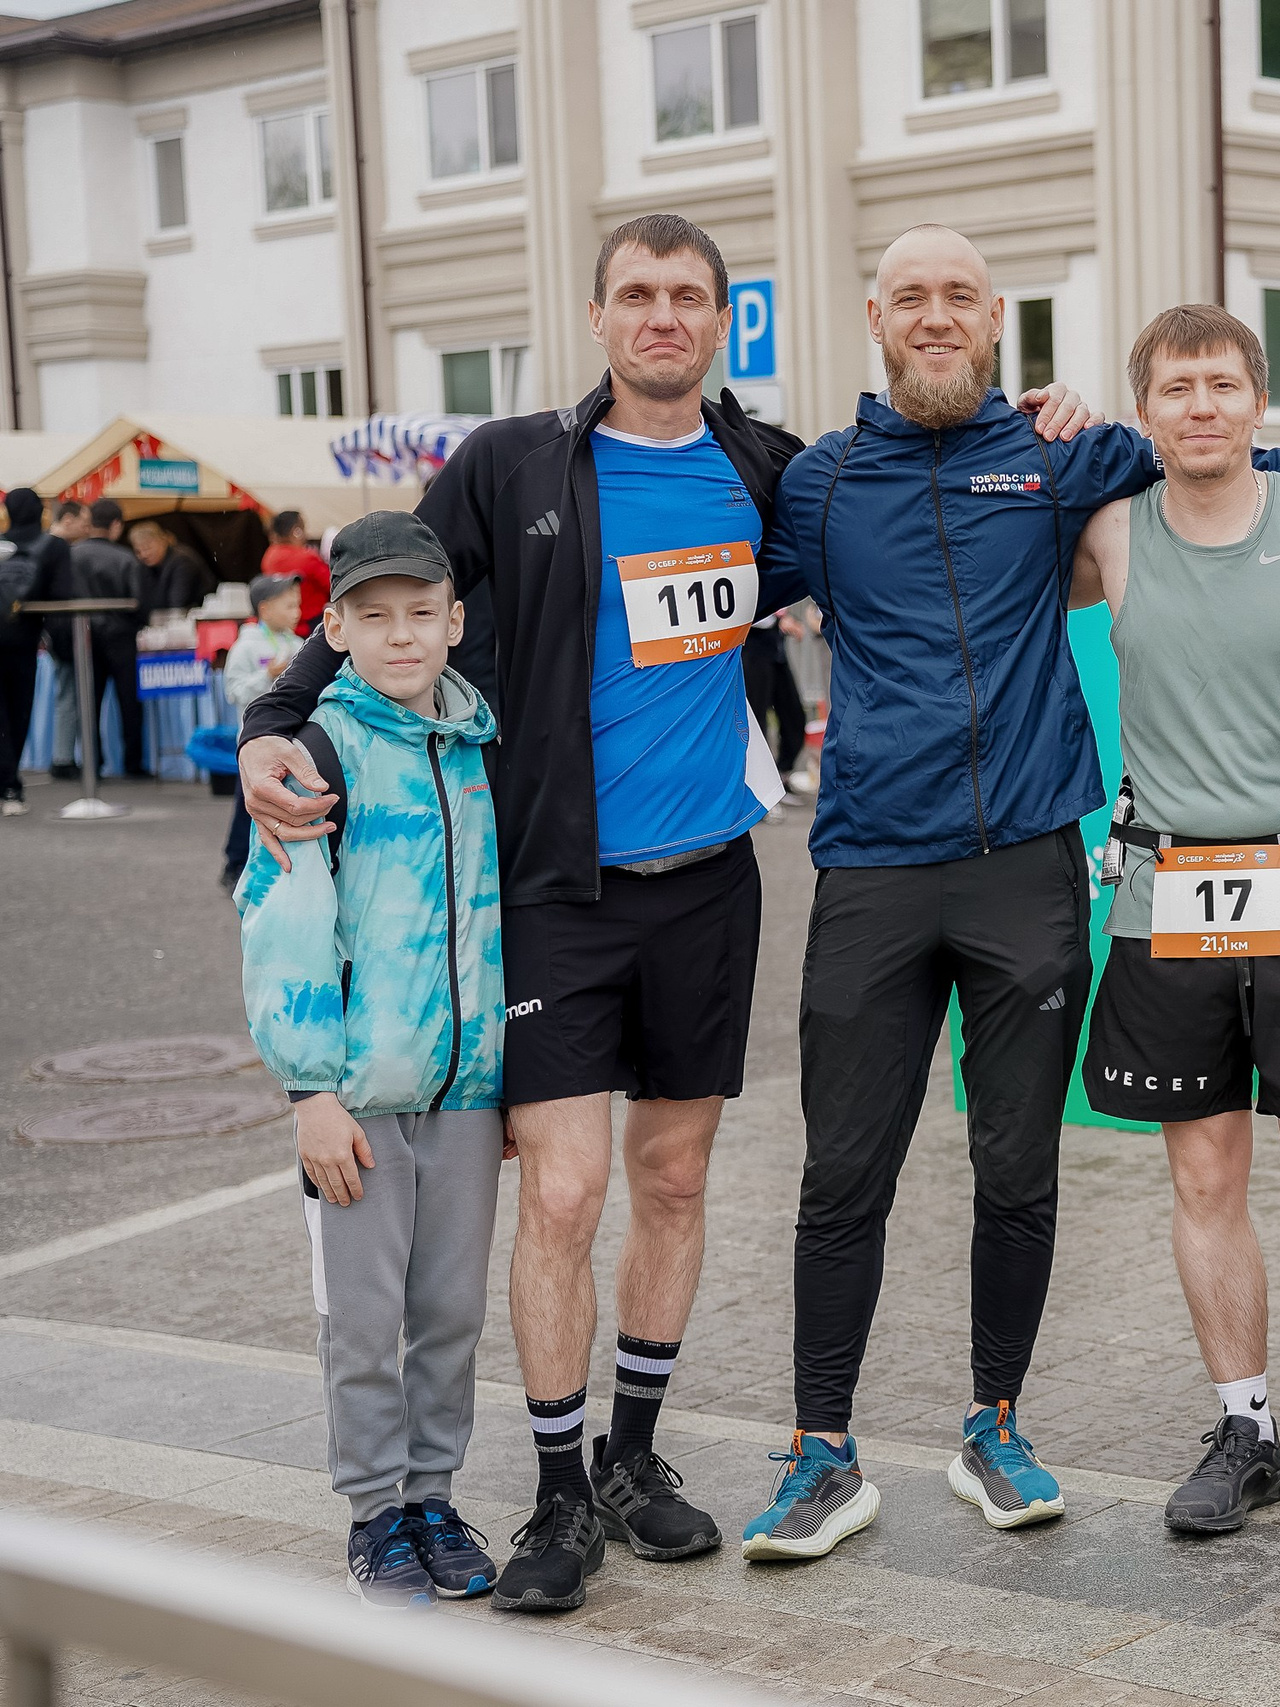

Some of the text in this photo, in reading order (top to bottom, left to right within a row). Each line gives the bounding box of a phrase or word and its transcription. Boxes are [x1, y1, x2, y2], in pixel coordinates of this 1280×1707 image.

[737, 289, 768, 372] P
[971, 483, 1025, 493] МАРАФОН
[657, 560, 677, 568] СБЕР
[658, 577, 735, 627] 110
[683, 636, 707, 655] 21,1
[1185, 855, 1204, 863] СБЕР
[1195, 879, 1253, 922] 17
[1200, 935, 1228, 954] 21,1
[505, 998, 543, 1022] mon
